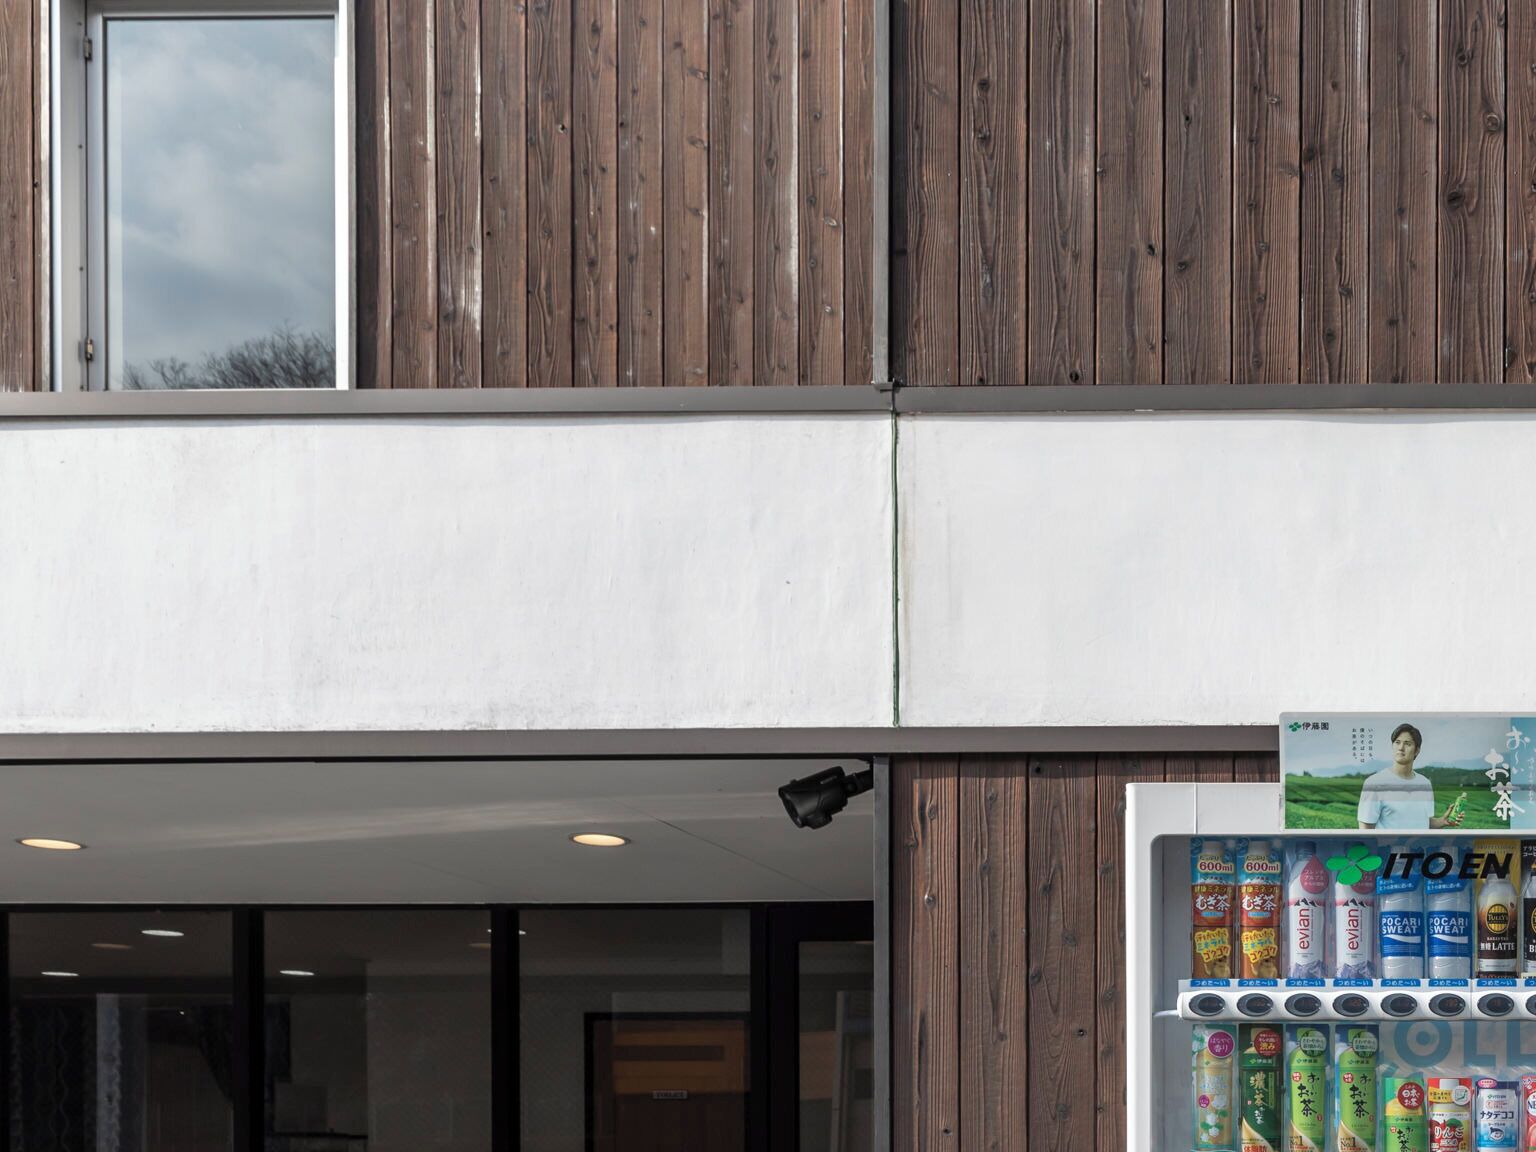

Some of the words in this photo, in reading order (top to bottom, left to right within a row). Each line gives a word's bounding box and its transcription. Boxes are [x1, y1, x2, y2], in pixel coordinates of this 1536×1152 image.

[1302, 722, 1329, 730] 伊藤園
[1199, 862, 1232, 872] 600ml
[1246, 862, 1279, 872] 600ml
[1383, 852, 1453, 880] ITO
[1458, 853, 1513, 880] EN
[1195, 894, 1231, 911] むぎ茶
[1242, 894, 1278, 911] むぎ茶
[1381, 918, 1421, 926] POCARI
[1429, 918, 1469, 926] POCARI
[1296, 908, 1310, 951] evian
[1345, 908, 1359, 951] evian
[1381, 926, 1418, 934] SWEAT
[1429, 926, 1466, 934] SWEAT
[1214, 1044, 1228, 1053] 香り
[1480, 1110, 1515, 1120] ナタデココ
[1434, 1126, 1464, 1139] りんご
